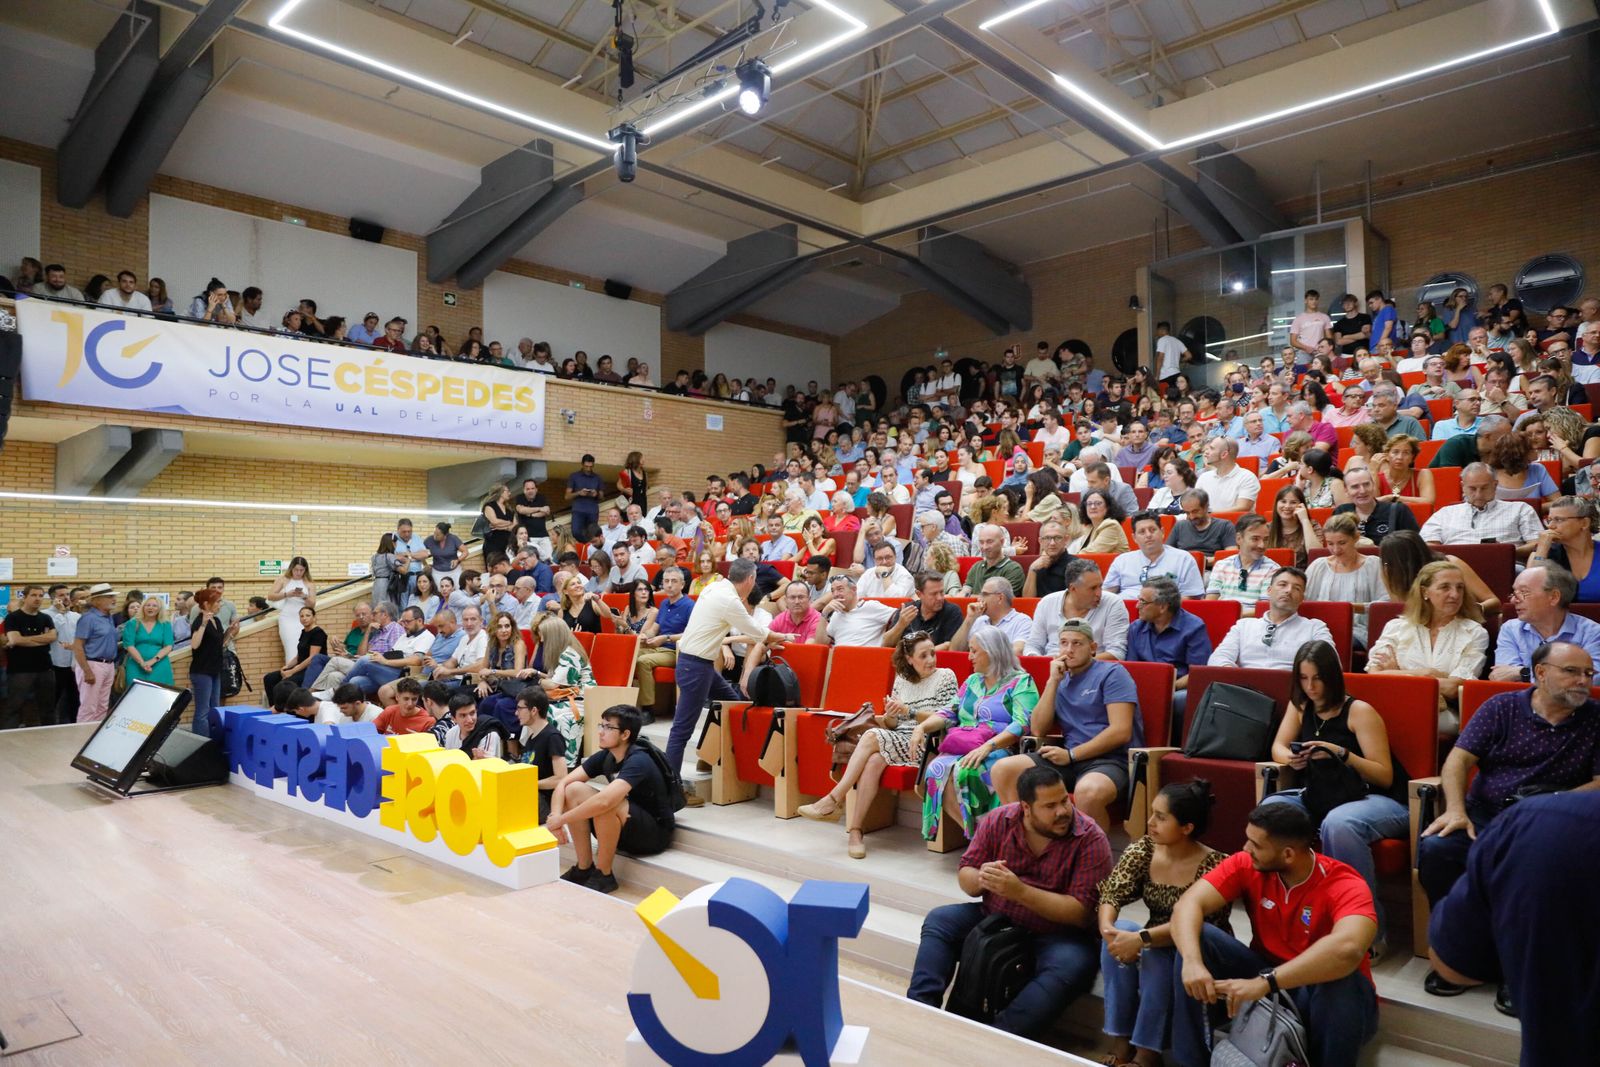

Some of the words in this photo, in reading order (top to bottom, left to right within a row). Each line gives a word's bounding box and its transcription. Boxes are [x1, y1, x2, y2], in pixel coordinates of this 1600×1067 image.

[208, 388, 260, 403] POR
[285, 397, 312, 409] LA
[335, 402, 379, 416] UAL
[399, 409, 438, 423] DEL
[457, 416, 538, 432] FUTURO
